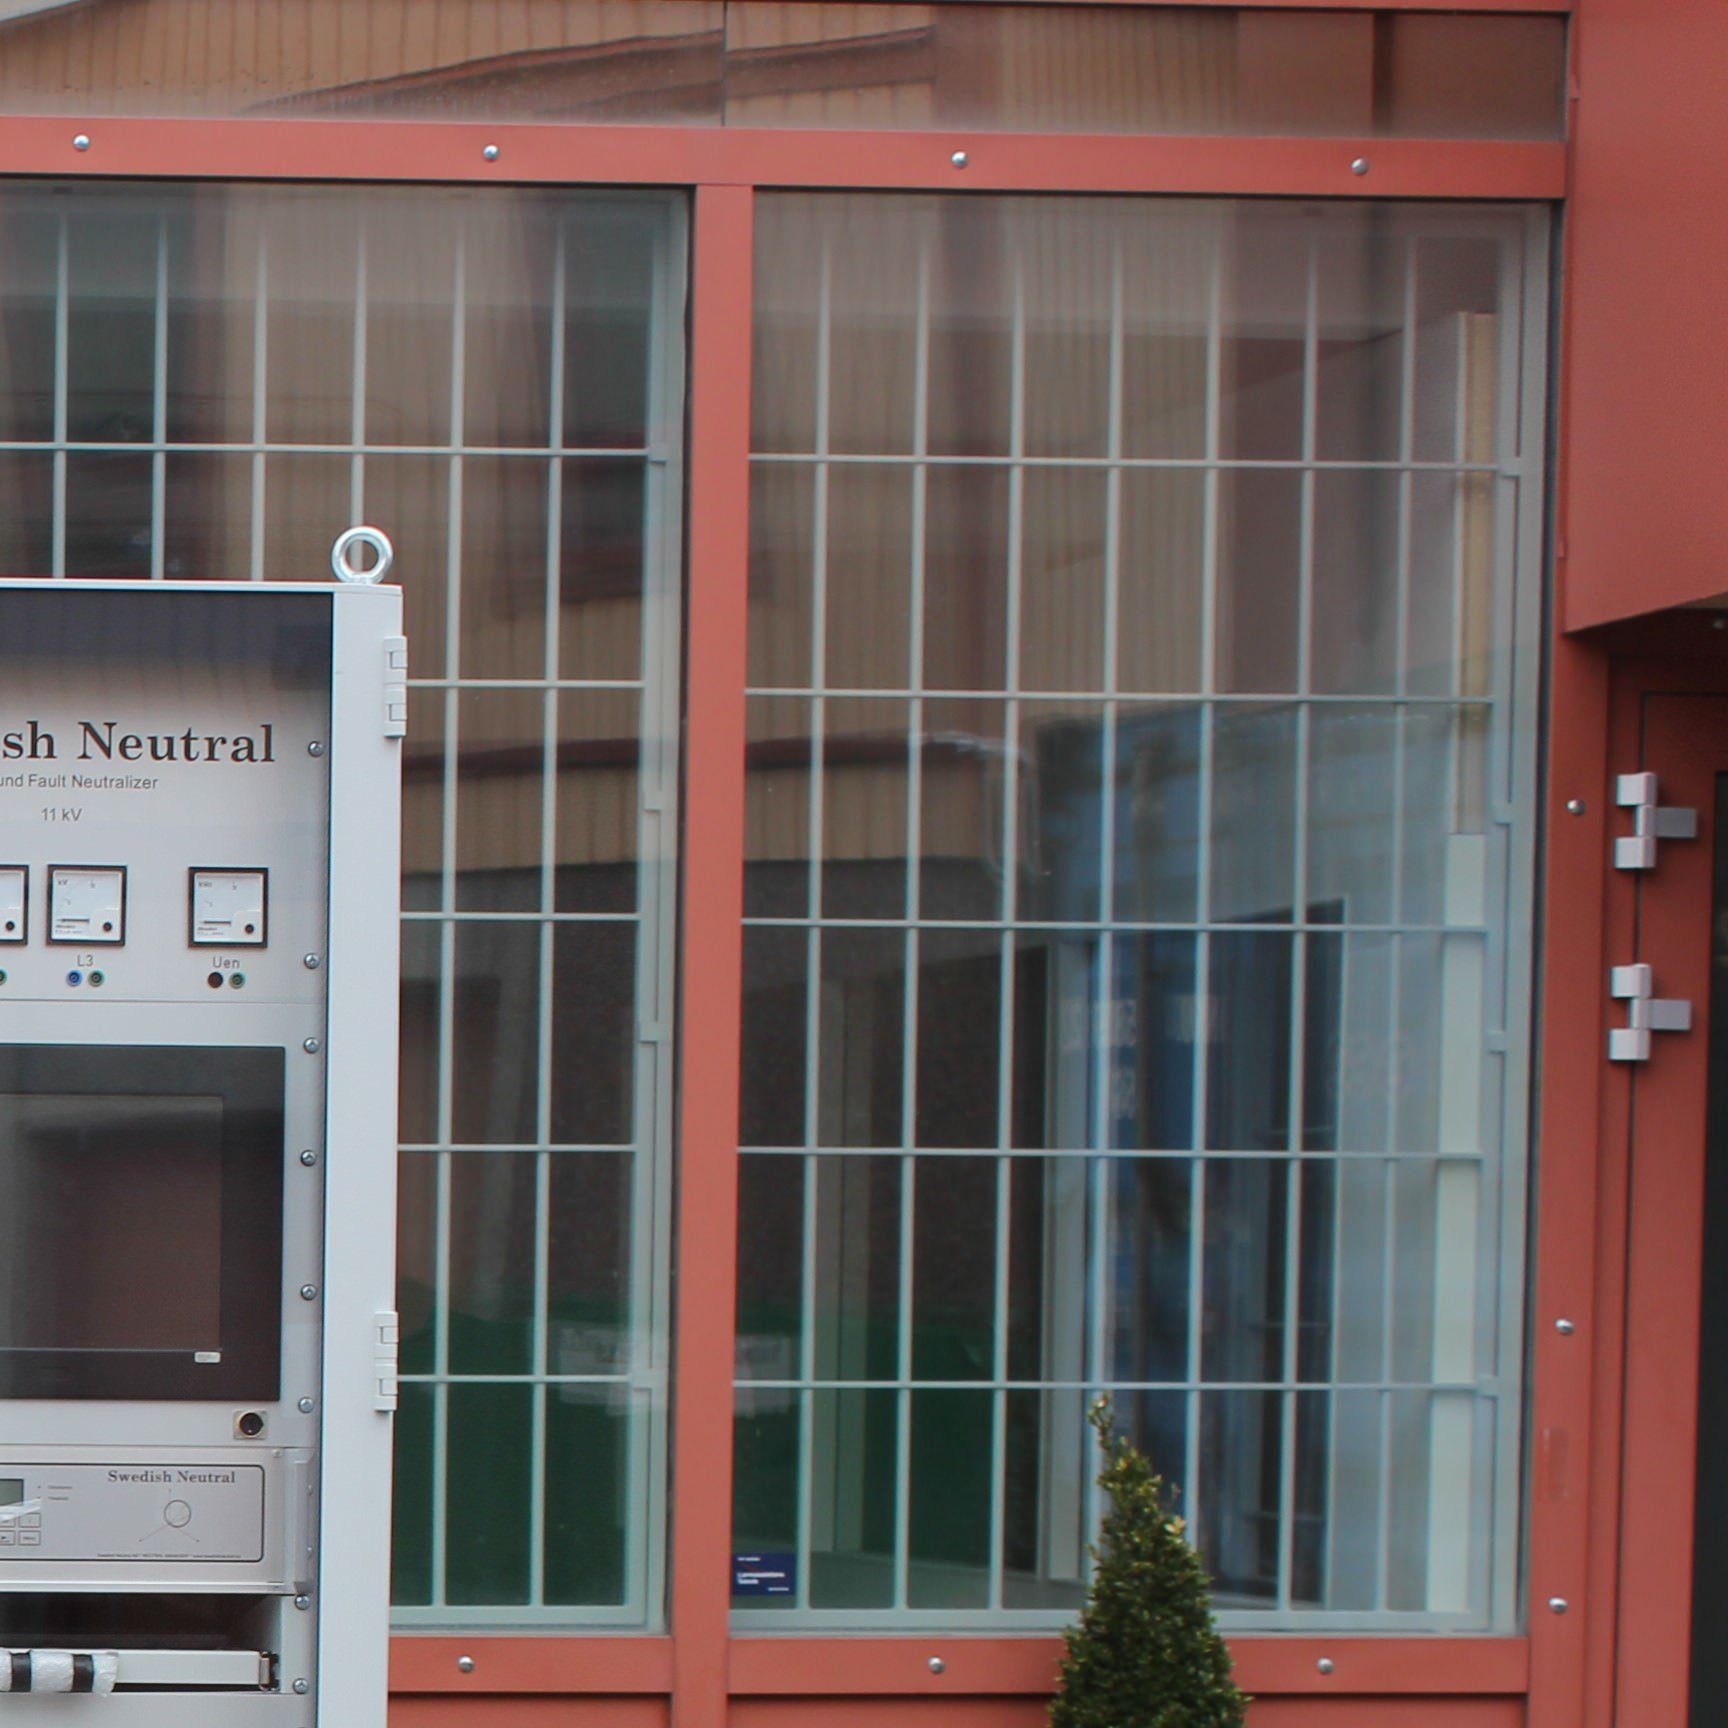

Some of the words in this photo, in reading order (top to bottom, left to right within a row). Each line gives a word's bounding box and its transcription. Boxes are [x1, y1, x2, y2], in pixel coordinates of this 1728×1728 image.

[78, 721, 275, 763] Neutral
[28, 773, 67, 788] Fault
[71, 774, 159, 790] Neutralizer
[41, 807, 56, 822] 11
[61, 807, 83, 822] kV
[77, 954, 94, 968] L3
[212, 956, 241, 970] Uen
[107, 1469, 173, 1485] Swedish
[177, 1470, 237, 1485] Neutral
